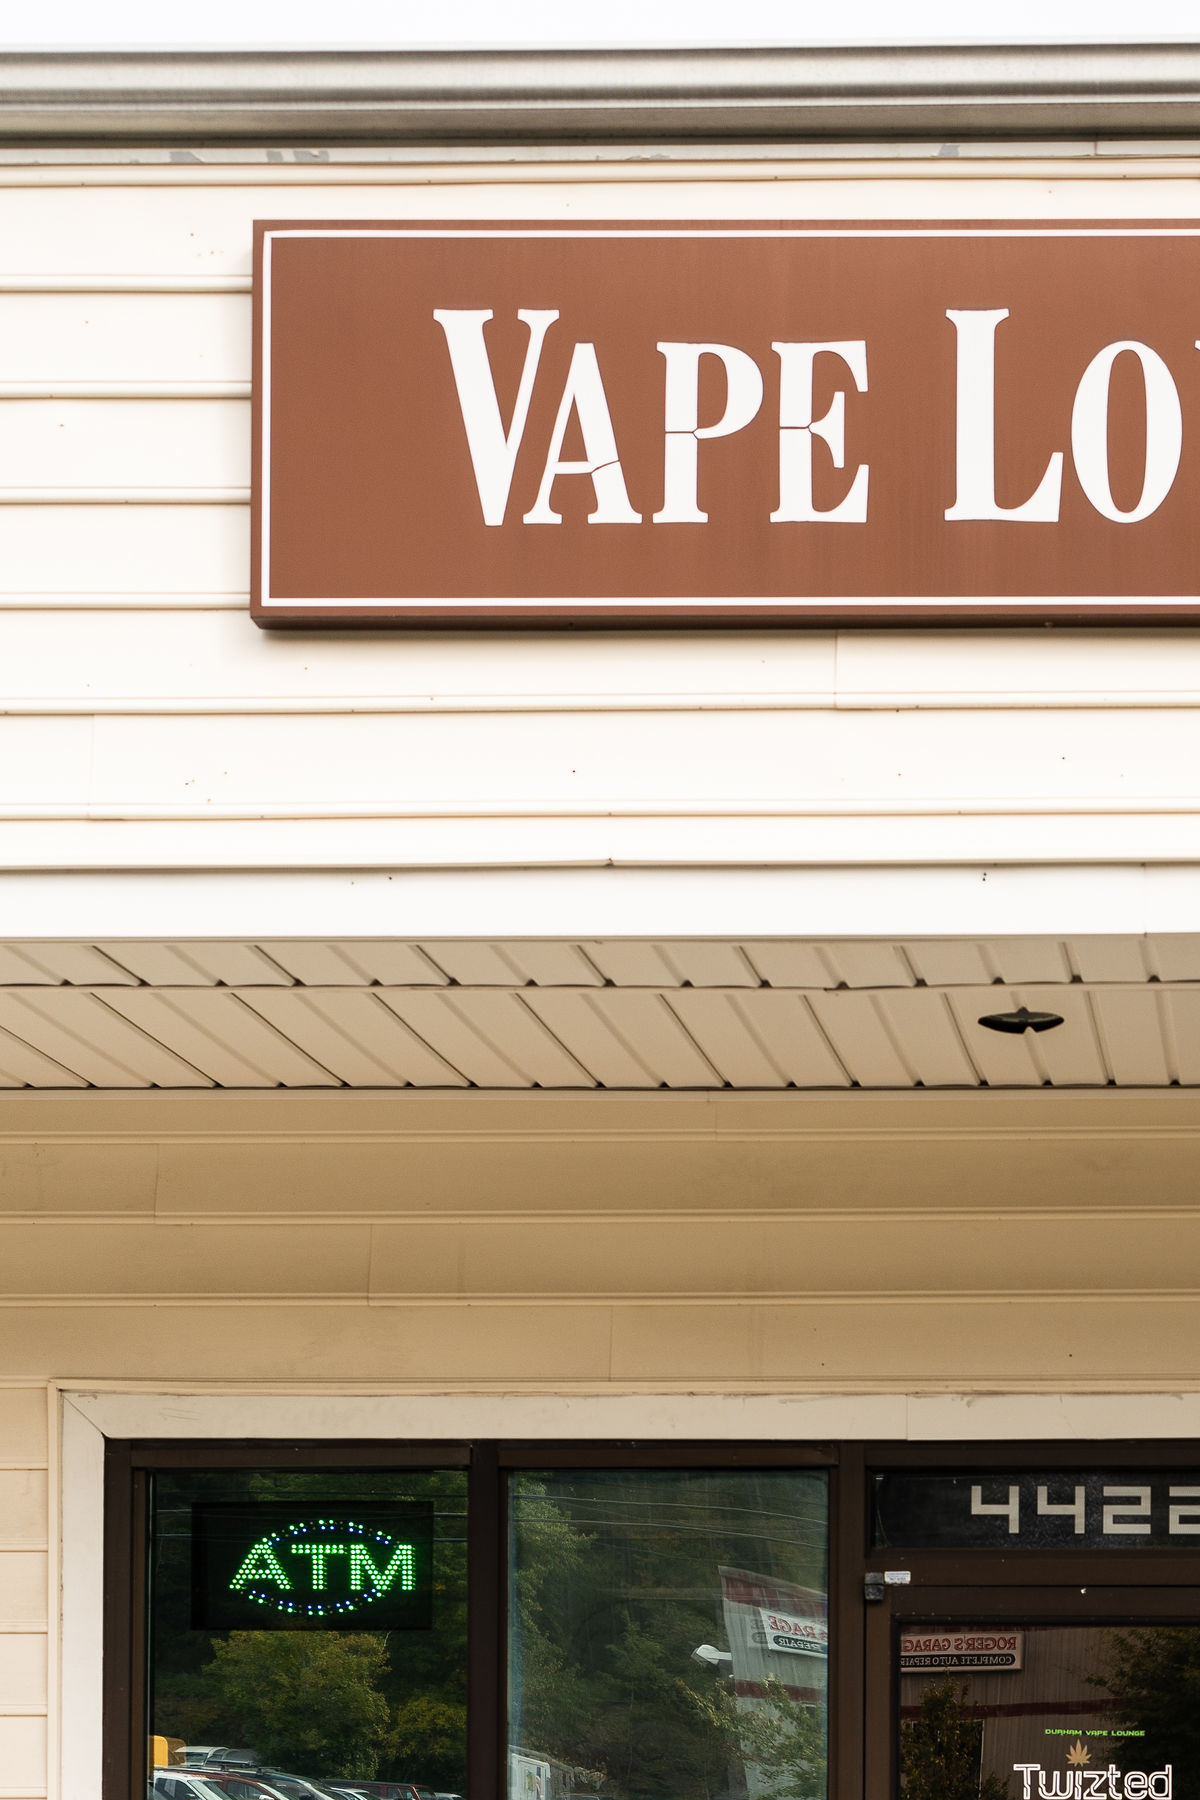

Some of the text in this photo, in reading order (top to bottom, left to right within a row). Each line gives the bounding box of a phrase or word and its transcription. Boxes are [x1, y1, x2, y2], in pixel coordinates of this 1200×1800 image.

[434, 309, 868, 525] VAPE
[228, 1543, 415, 1591] ATM
[1013, 1763, 1173, 1800] Twizted
